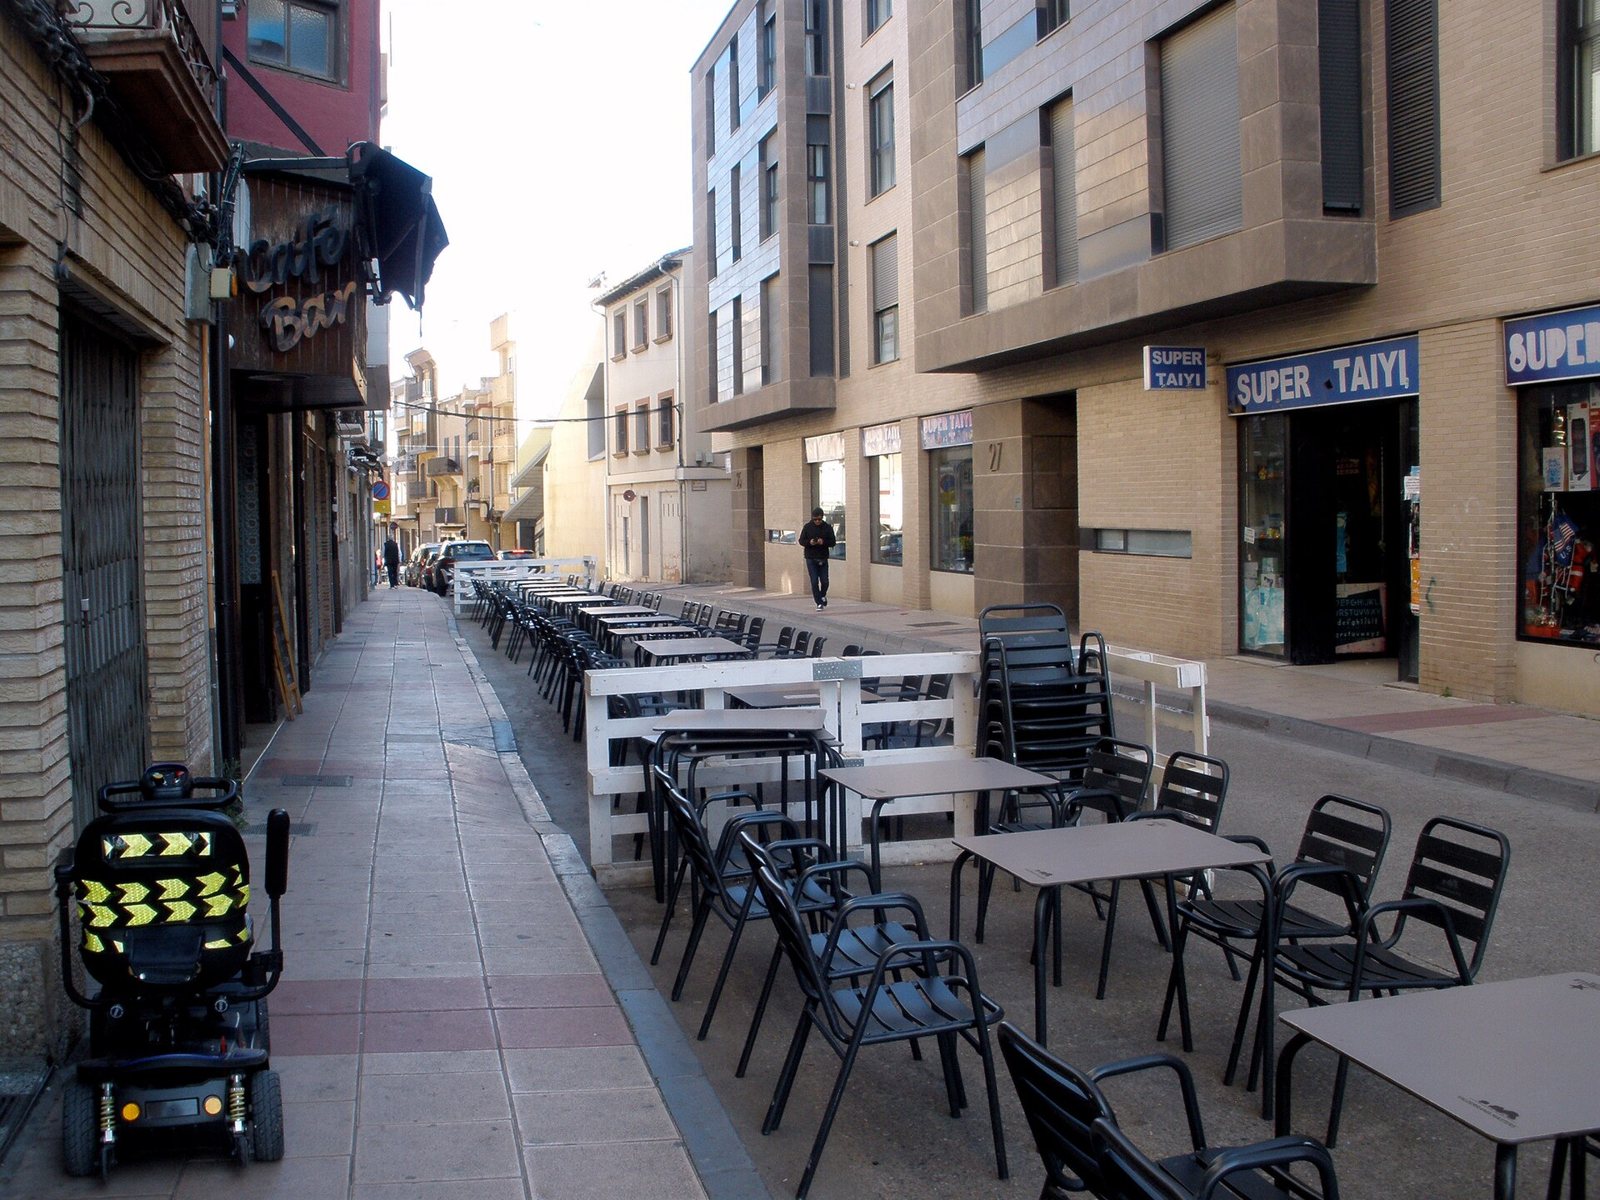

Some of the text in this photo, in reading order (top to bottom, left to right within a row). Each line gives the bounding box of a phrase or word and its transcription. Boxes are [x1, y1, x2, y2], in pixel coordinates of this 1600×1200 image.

[261, 281, 357, 352] Bar
[1152, 350, 1202, 366] SUPER
[1155, 372, 1201, 387] TAIYI
[1237, 349, 1410, 406] SUPER TAIYI
[989, 442, 1003, 472] 27
